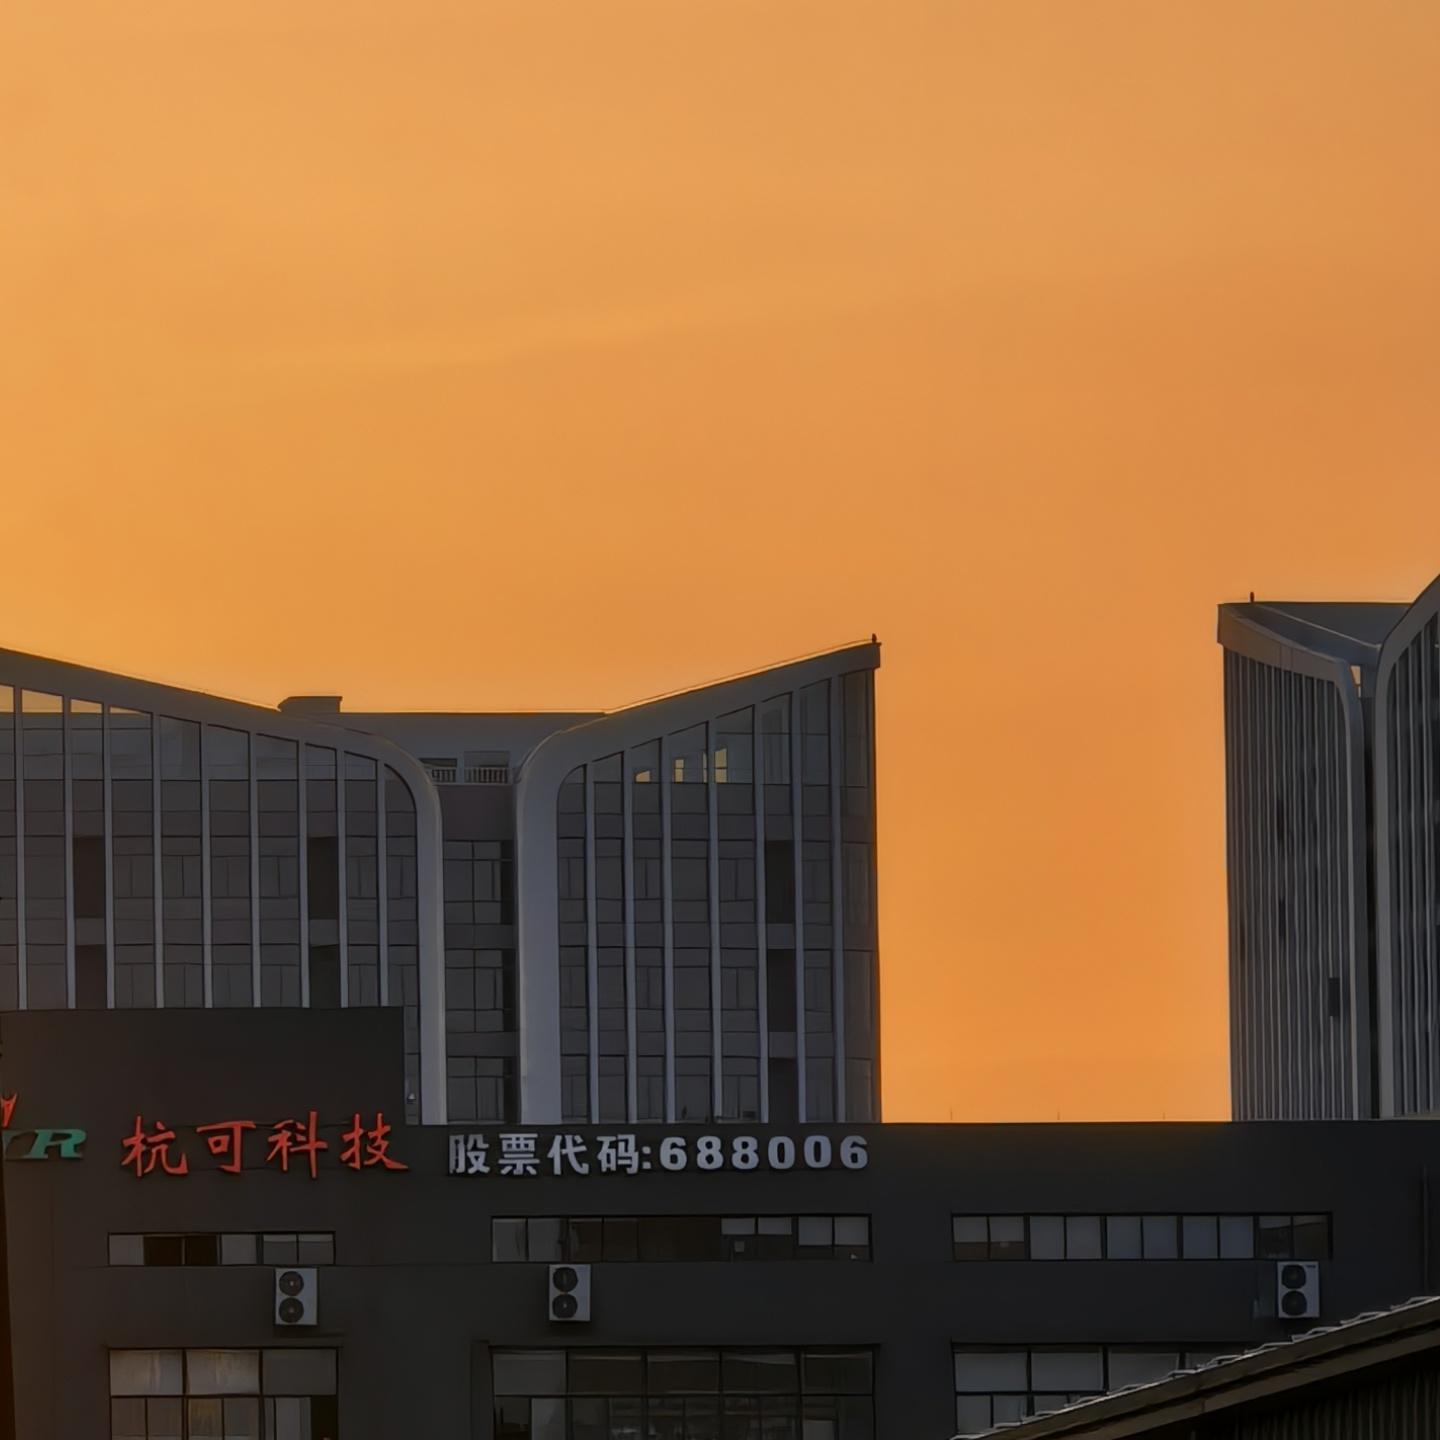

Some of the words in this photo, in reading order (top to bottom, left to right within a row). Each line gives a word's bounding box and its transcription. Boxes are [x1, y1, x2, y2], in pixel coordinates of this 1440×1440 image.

[121, 1111, 410, 1179] 杭可科技
[447, 1130, 870, 1177] 股票代码:688006
